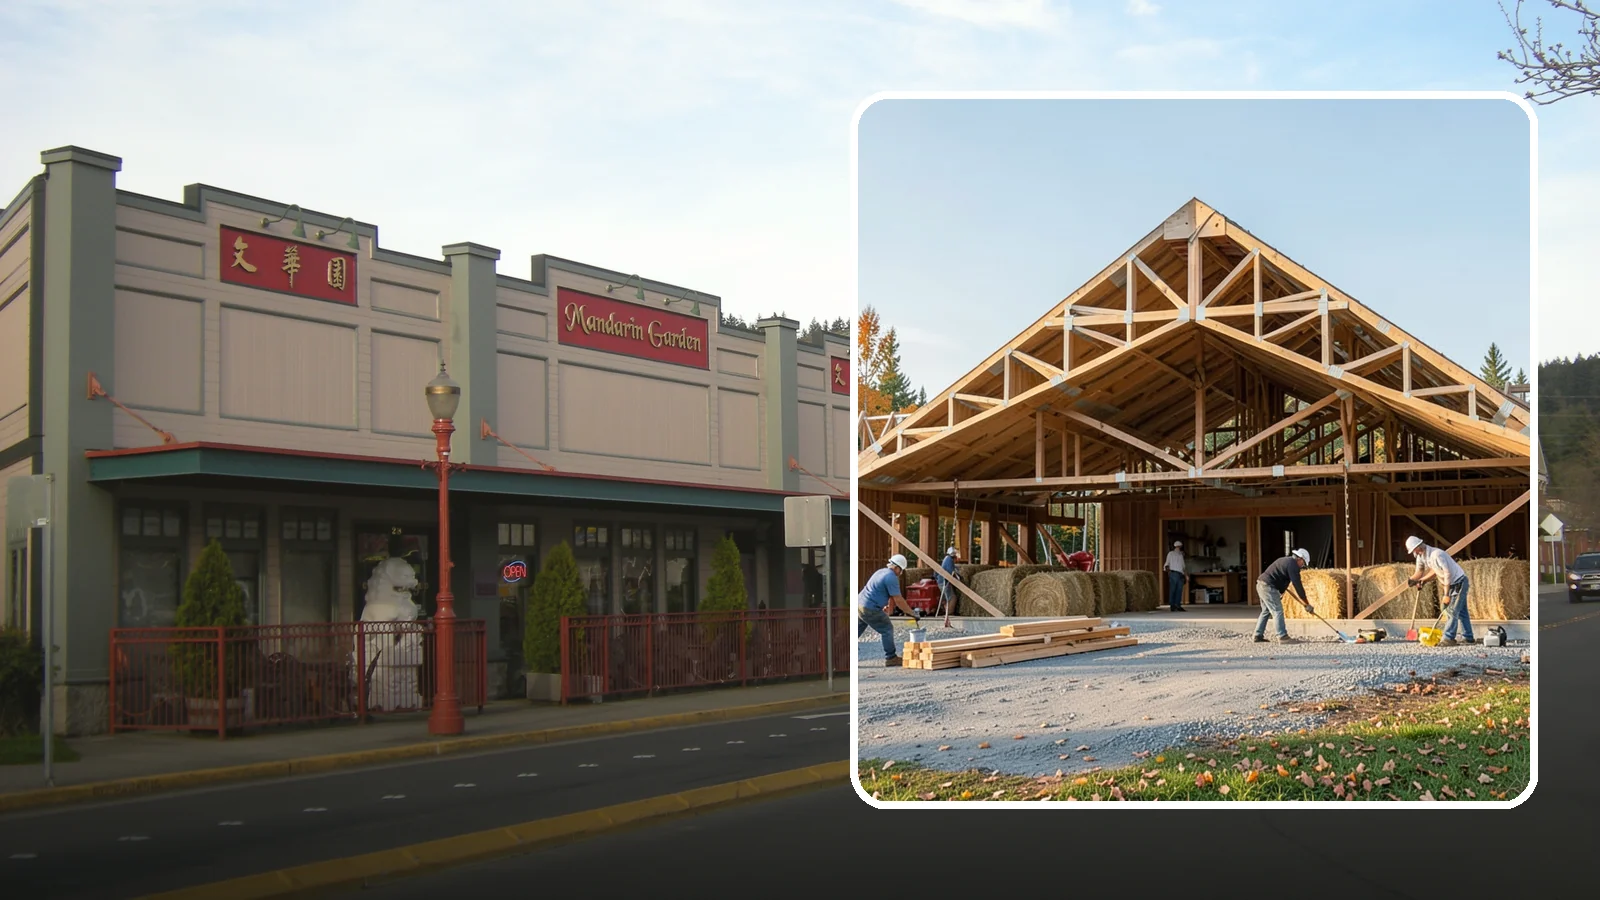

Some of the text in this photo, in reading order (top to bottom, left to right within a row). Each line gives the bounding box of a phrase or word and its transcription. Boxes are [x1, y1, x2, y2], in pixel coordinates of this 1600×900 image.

[231, 236, 346, 291] 文華園
[564, 302, 701, 352] Mandarin Garden
[503, 565, 527, 578] OPEN
